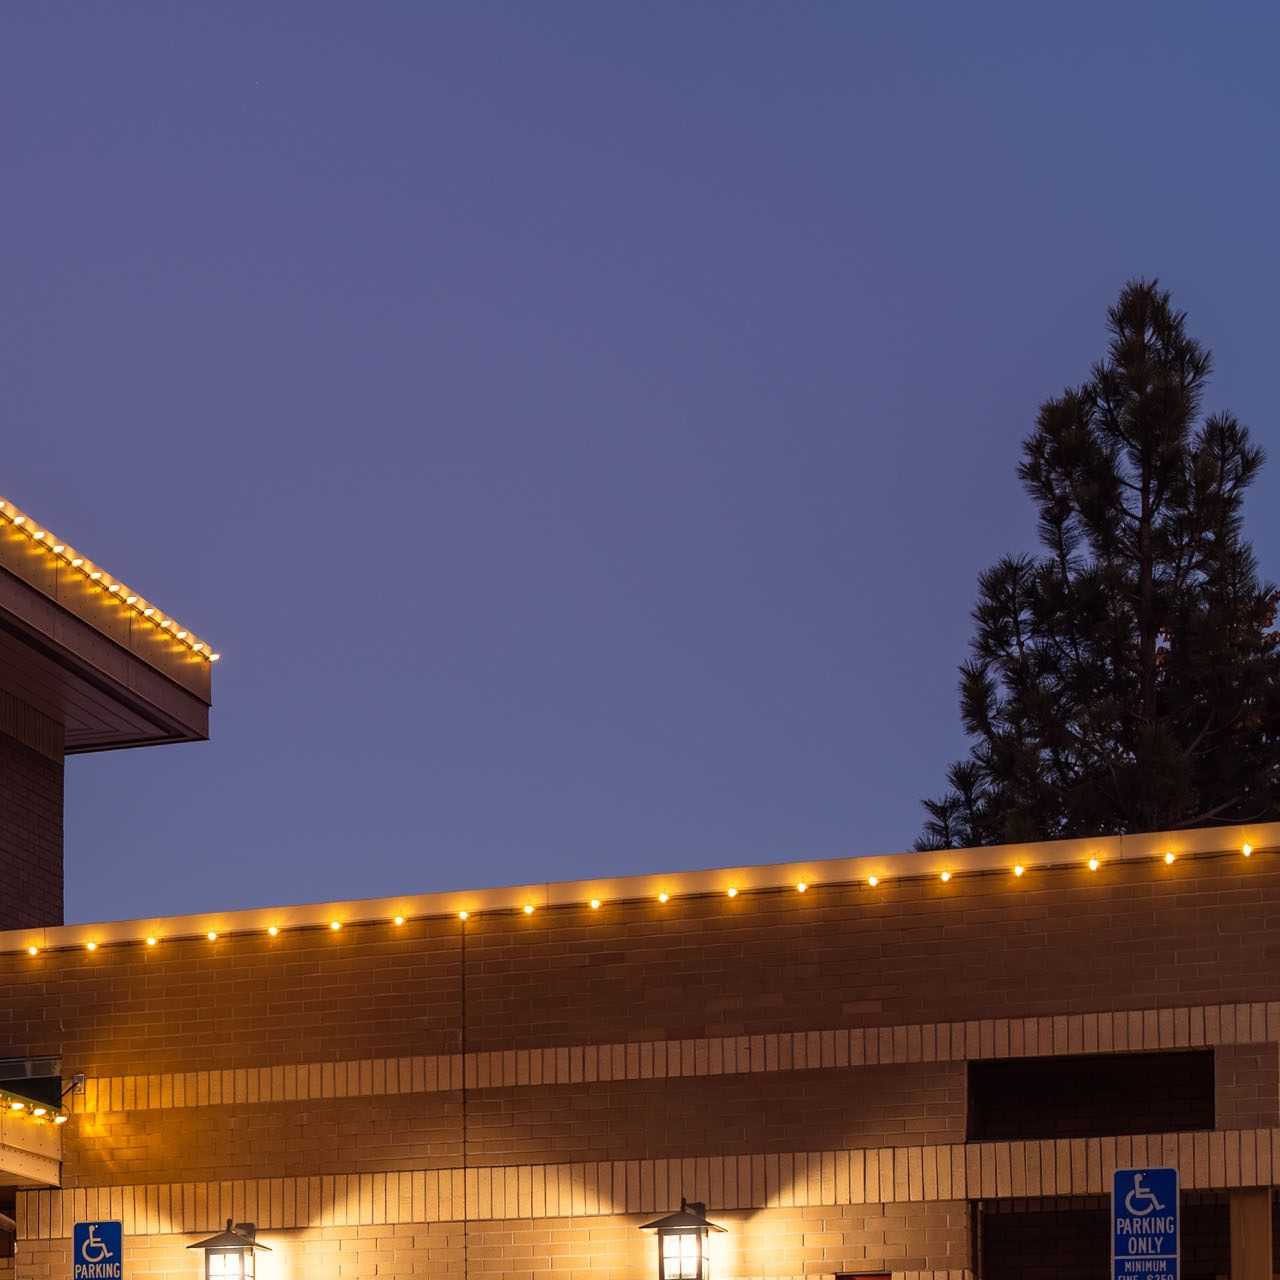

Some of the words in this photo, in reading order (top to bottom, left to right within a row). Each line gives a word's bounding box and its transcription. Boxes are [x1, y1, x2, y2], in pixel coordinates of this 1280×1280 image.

[1116, 1216, 1175, 1234] PARKING
[1128, 1236, 1164, 1254] ONLY
[75, 1263, 120, 1279] PARKING
[1124, 1260, 1167, 1273] MINIMUM
